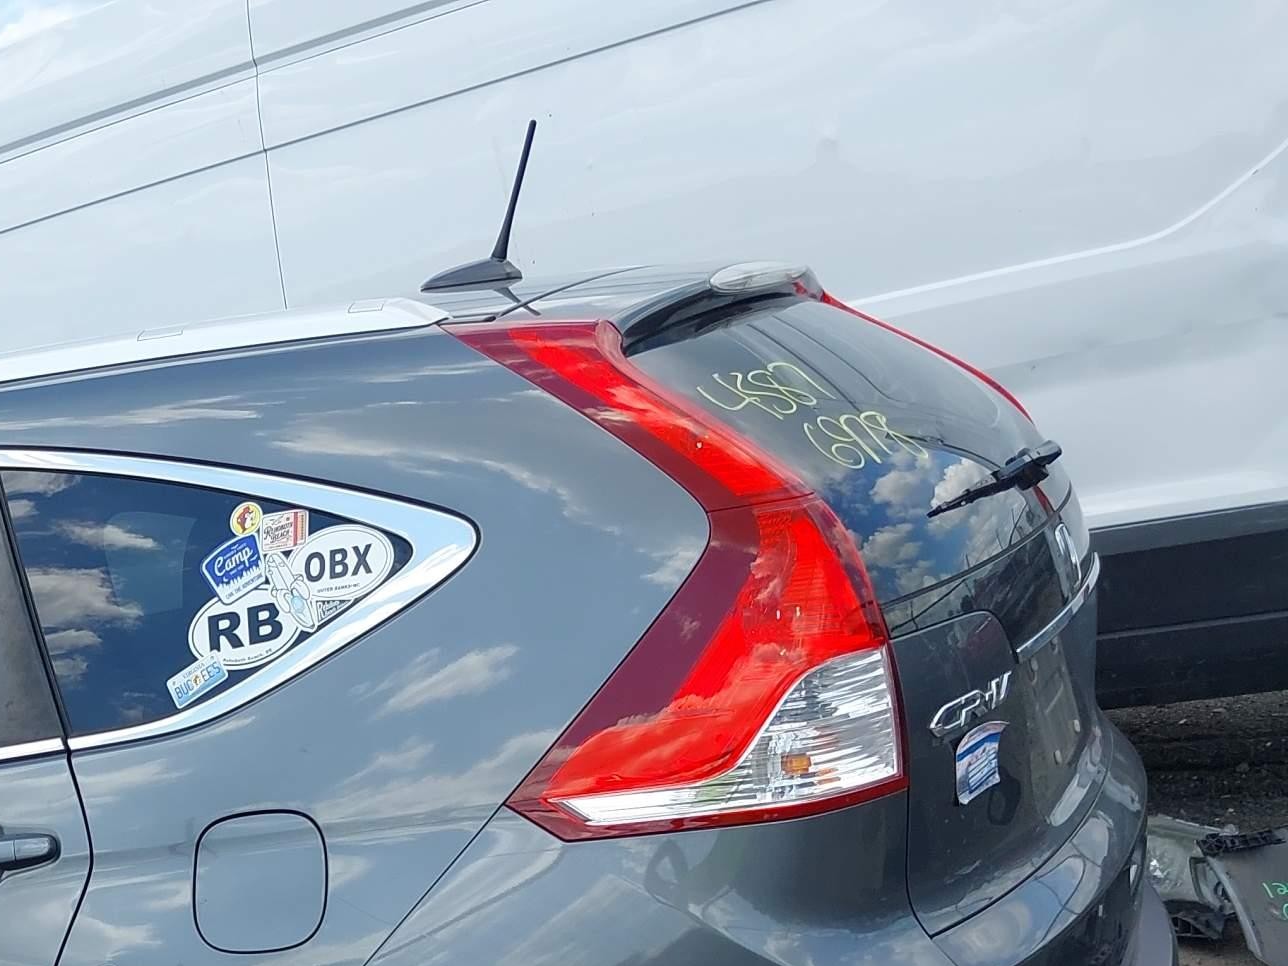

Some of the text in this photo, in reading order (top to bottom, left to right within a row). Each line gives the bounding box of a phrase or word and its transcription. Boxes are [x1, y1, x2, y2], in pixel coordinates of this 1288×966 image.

[695, 361, 838, 421] 4587
[803, 410, 929, 470] 6978
[214, 546, 254, 577] Camp
[303, 543, 374, 583] OBX
[207, 602, 284, 653] RB
